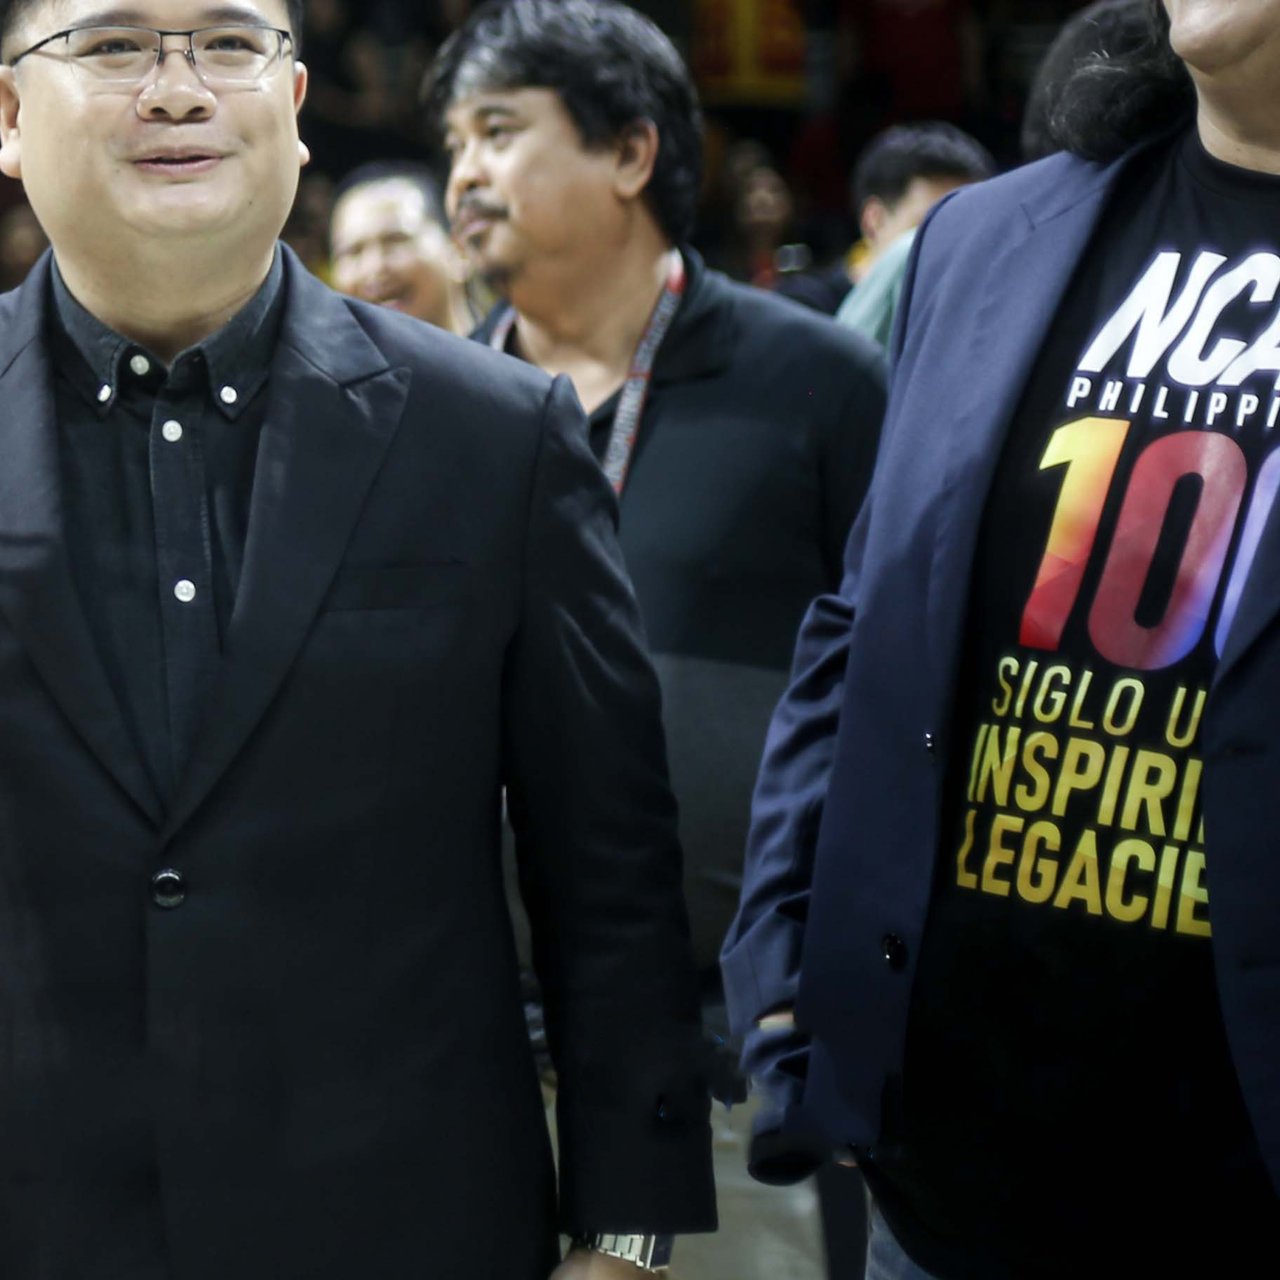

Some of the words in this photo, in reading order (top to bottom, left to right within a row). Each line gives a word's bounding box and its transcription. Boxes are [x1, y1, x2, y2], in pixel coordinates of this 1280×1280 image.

[1067, 376, 1280, 428] PHILIPPI
[992, 656, 1145, 737] SIGLO
[967, 723, 1205, 844] INSPIRI
[956, 809, 1213, 938] LEGACIE
